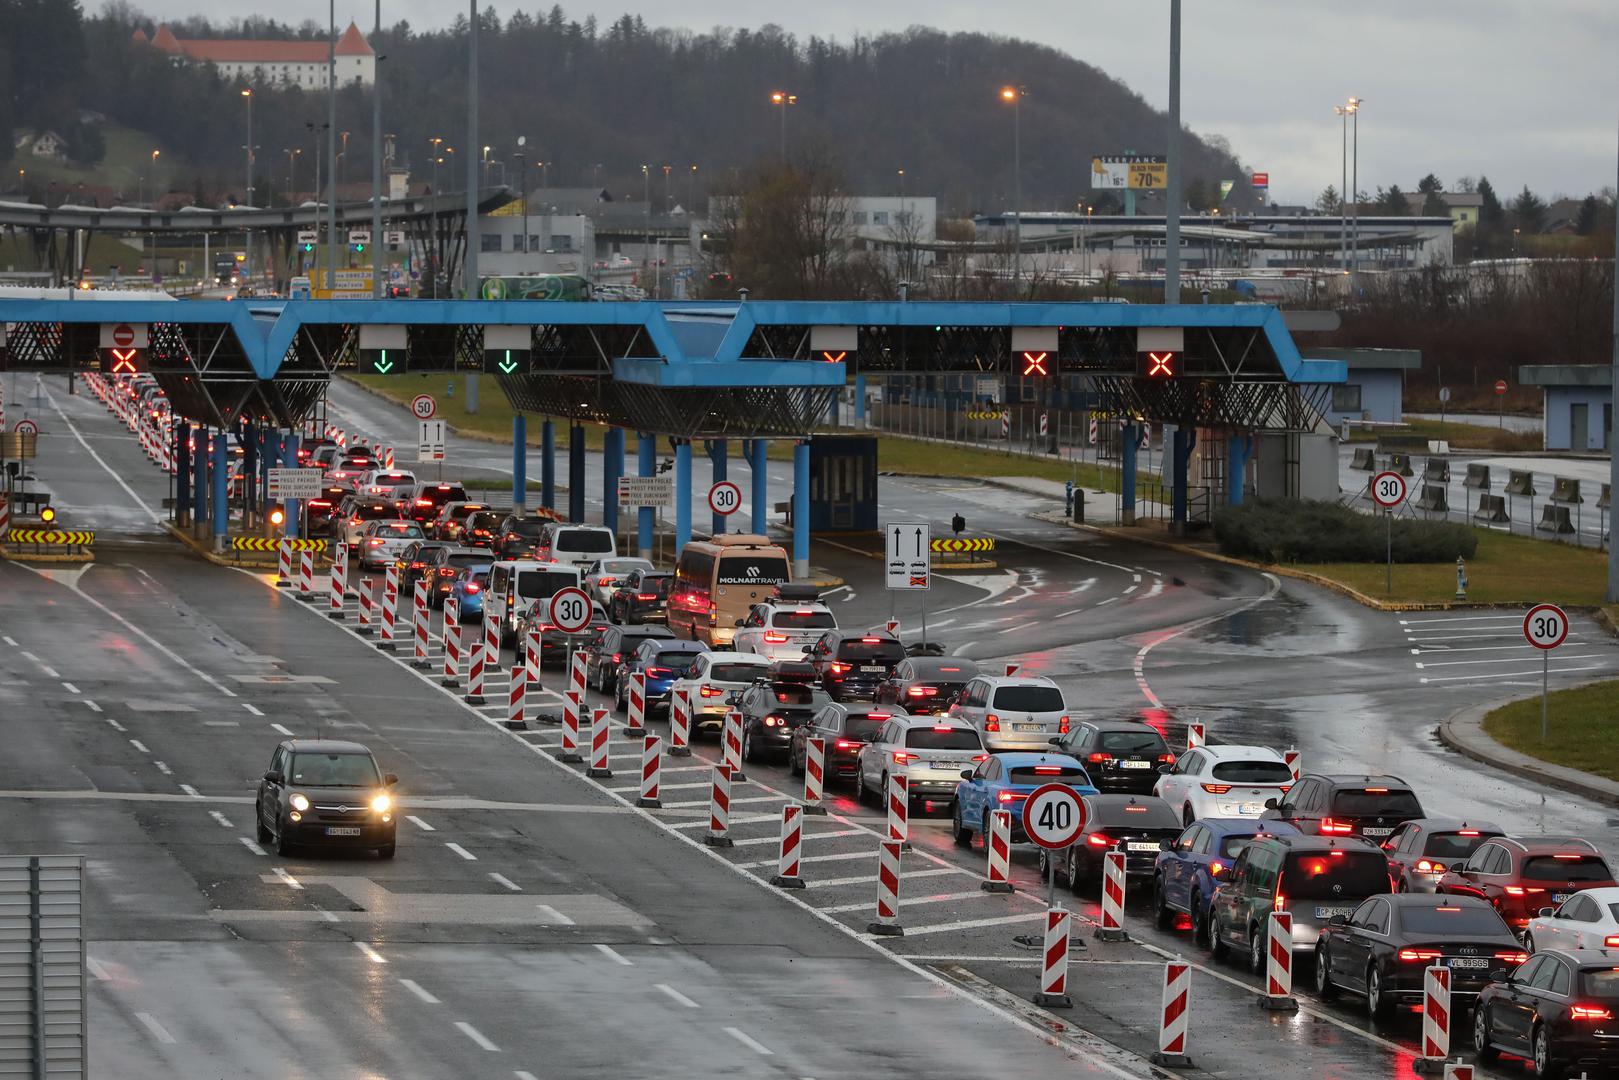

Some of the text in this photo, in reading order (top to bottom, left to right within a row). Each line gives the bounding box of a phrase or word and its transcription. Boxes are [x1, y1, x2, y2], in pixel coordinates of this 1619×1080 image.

[417, 402, 430, 413] 50
[1380, 480, 1398, 497] 30
[717, 490, 734, 506] 30
[561, 600, 583, 620] 30
[1534, 617, 1558, 638] 30
[1038, 801, 1071, 831] 40
